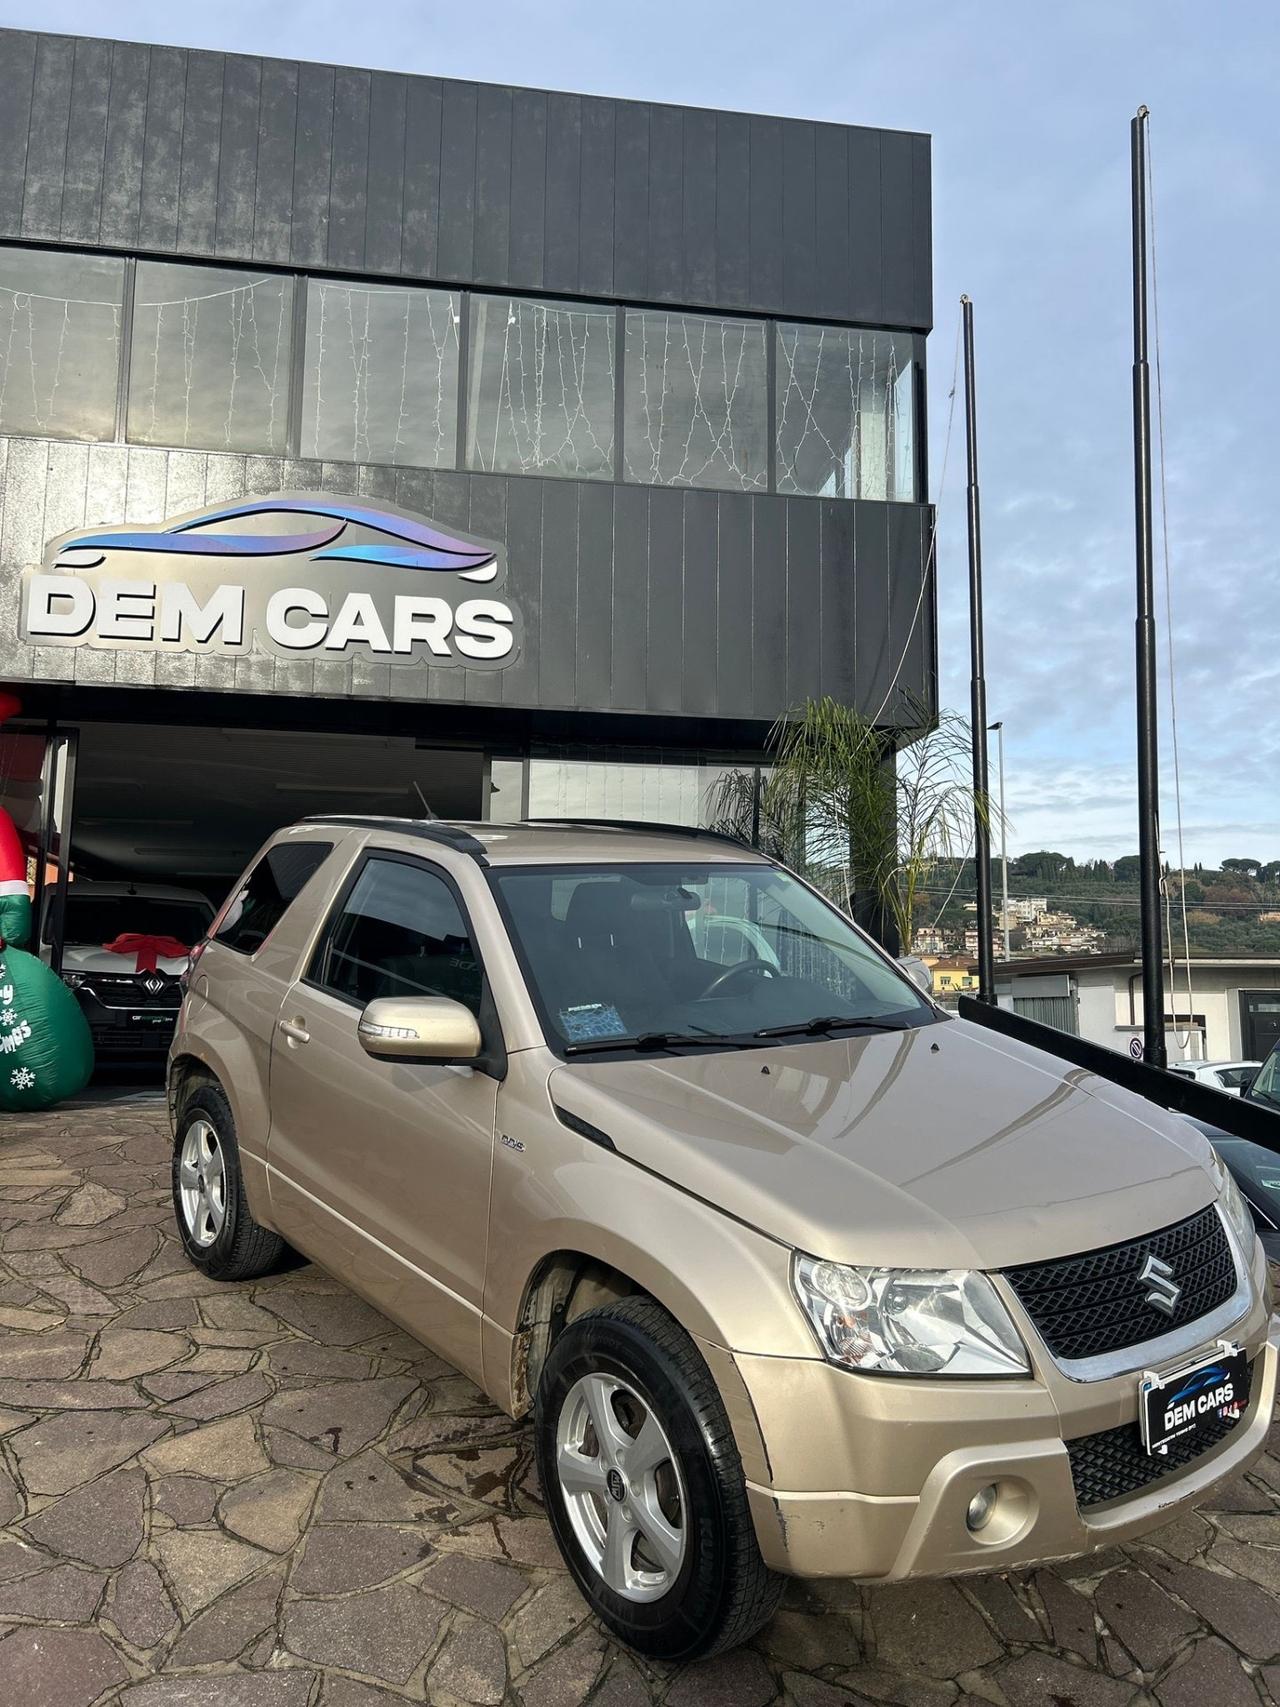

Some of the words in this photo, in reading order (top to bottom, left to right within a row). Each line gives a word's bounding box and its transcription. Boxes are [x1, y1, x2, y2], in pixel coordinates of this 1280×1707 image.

[27, 574, 245, 644] DEM
[264, 587, 514, 659] CARS
[1164, 1401, 1197, 1431] DEM
[1197, 1383, 1235, 1414] CARS
